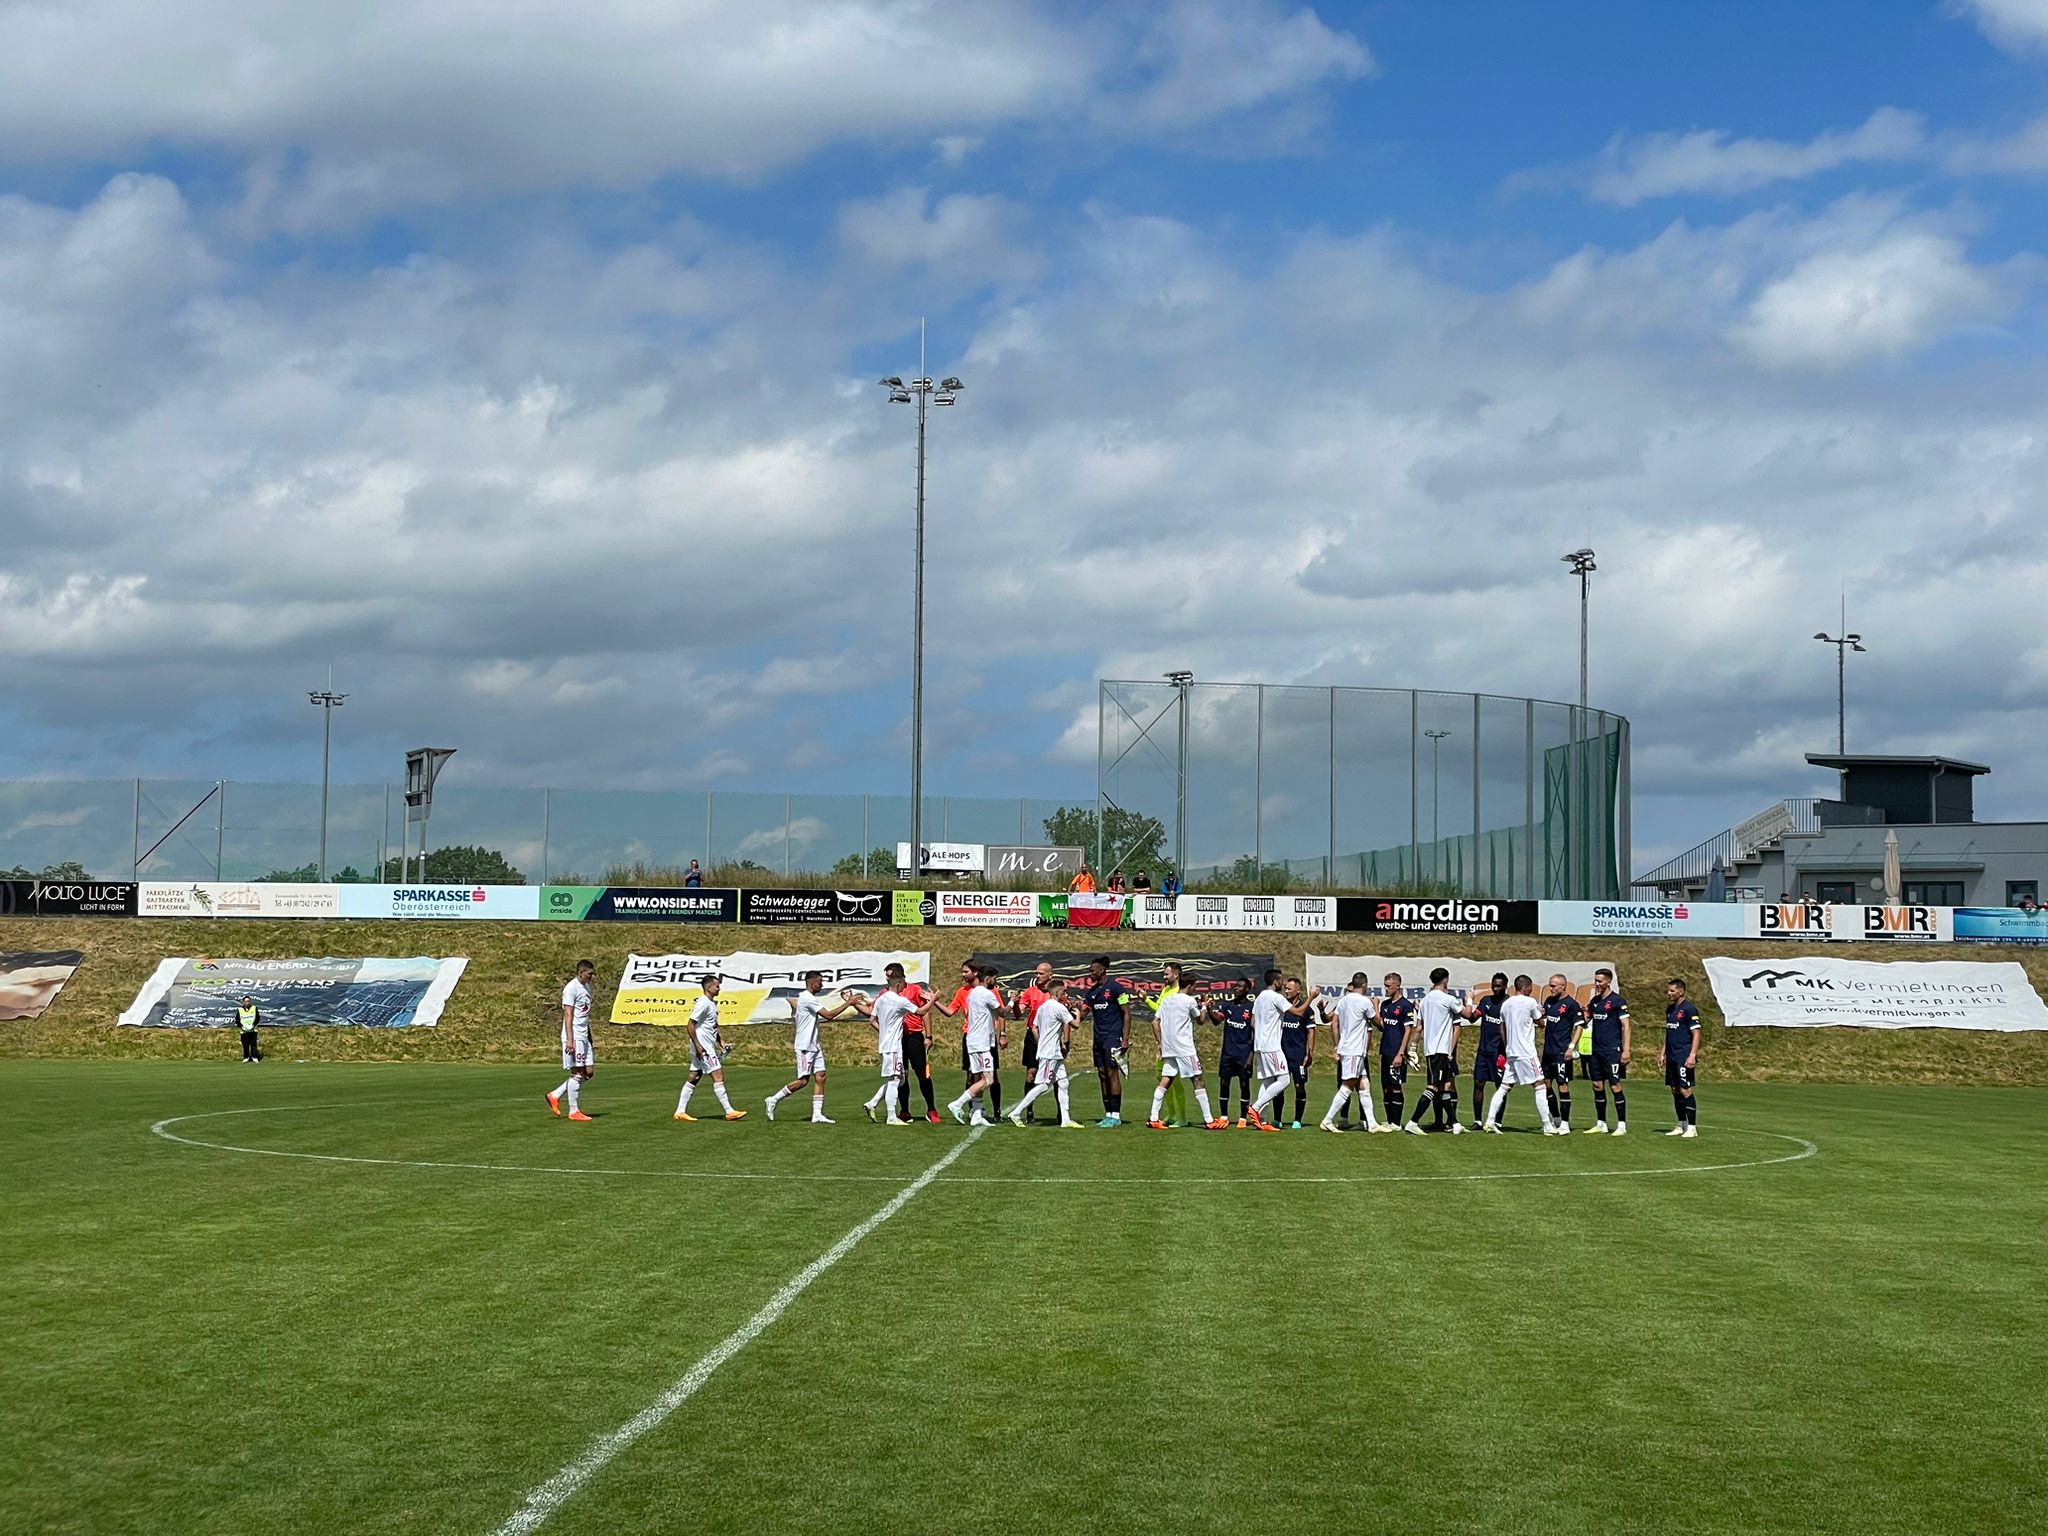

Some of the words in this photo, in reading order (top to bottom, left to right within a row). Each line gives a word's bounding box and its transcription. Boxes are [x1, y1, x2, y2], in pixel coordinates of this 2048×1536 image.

[28, 886, 84, 900] MOLTO
[393, 890, 471, 901] SPARKASSE
[392, 902, 470, 911] Oberösterreich
[613, 897, 724, 909] WWW.ONSIDE.NET
[749, 894, 831, 910] Schwabegger
[943, 895, 1007, 906] ENERGIE
[1009, 896, 1031, 907] AG
[1376, 900, 1499, 921] amedien
[1593, 906, 1672, 919] SPARKASSE
[1000, 917, 1031, 925] morgen
[1145, 914, 1176, 925] JEANS
[1196, 914, 1227, 925] JEANS
[1243, 915, 1274, 926] JEANS
[1295, 916, 1326, 927] JEANS
[1760, 905, 1824, 929] BMR
[1864, 907, 1929, 931] BMR
[1376, 922, 1409, 930] werbe-
[1411, 922, 1430, 930] und
[1433, 922, 1467, 932] verlags
[1469, 922, 1498, 933] gmbh
[1592, 919, 1673, 929] Oberösterreich
[634, 960, 721, 969] HUBER
[1795, 979, 1834, 990] MK
[1838, 981, 2004, 993] Vermietungen
[576, 1053, 586, 1063] 99
[984, 1059, 990, 1068] 2
[1680, 1067, 1686, 1078] 8
